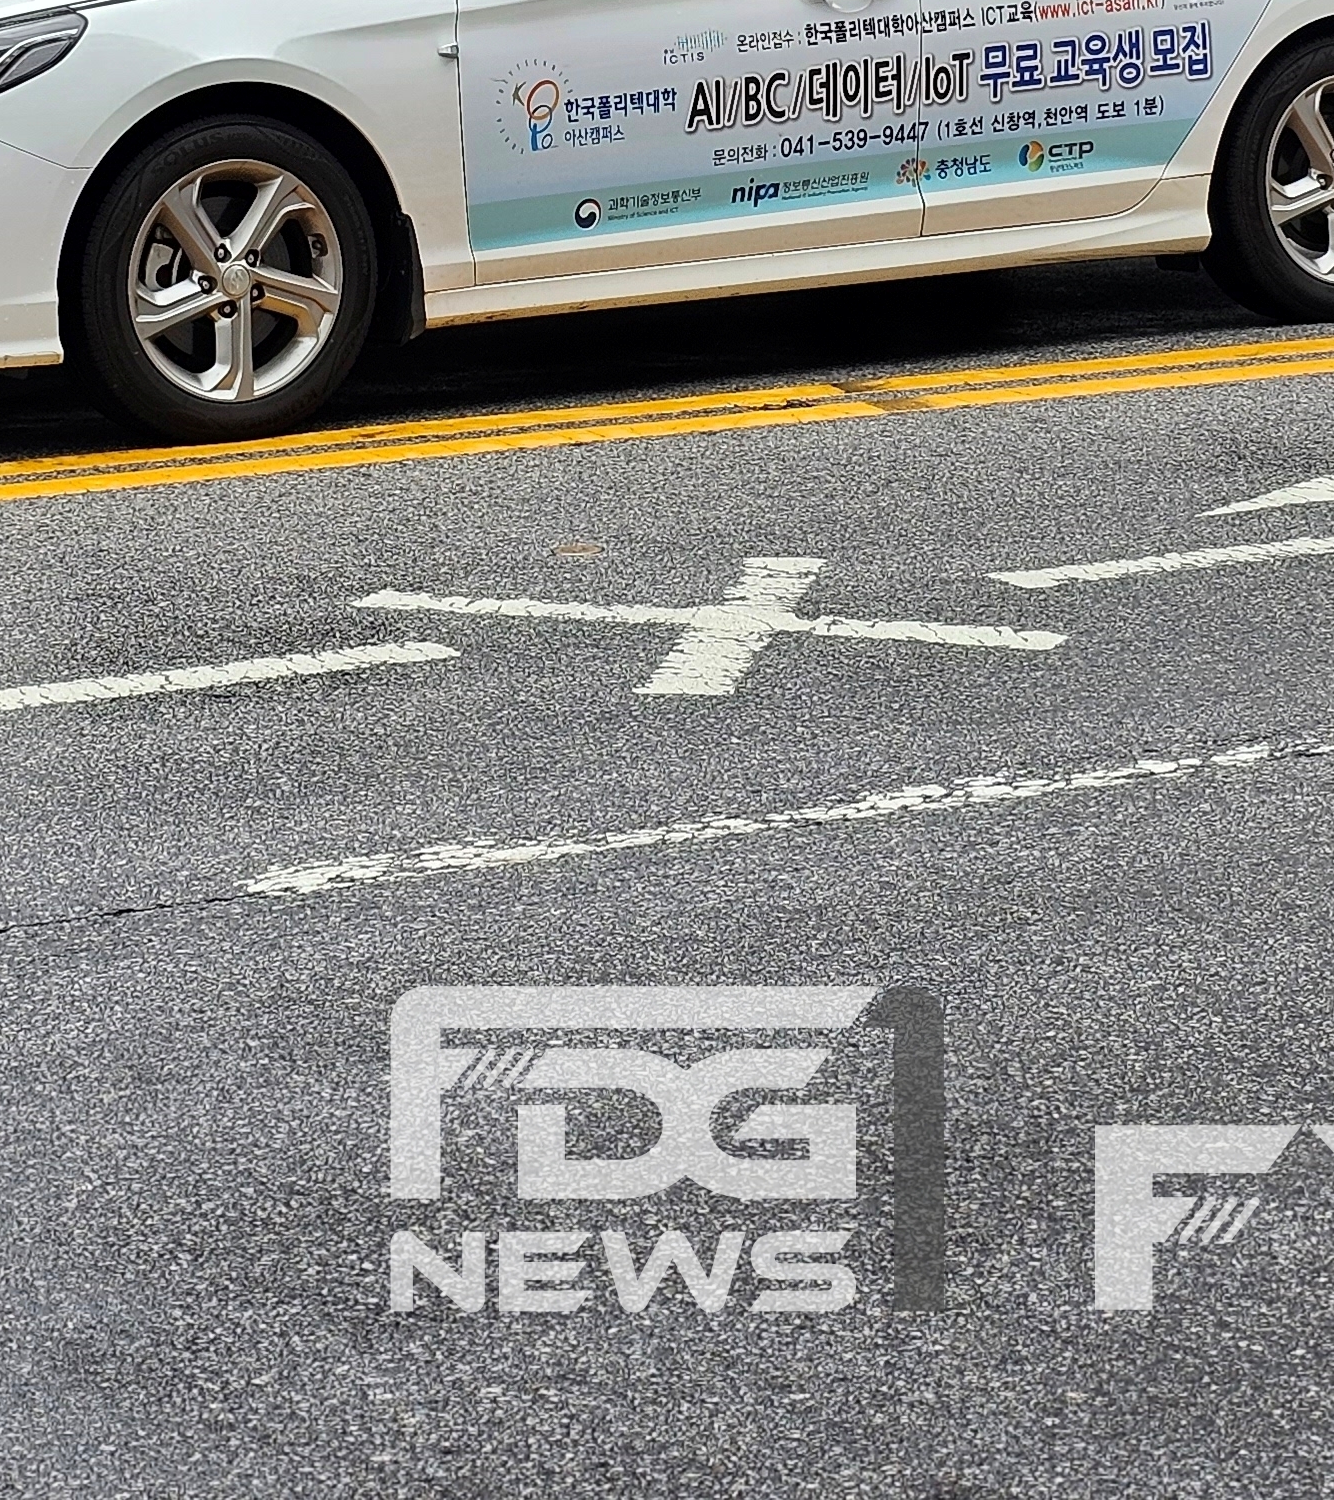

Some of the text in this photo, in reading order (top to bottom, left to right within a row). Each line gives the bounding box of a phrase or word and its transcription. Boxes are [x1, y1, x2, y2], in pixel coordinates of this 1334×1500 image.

[804, 6, 976, 47] 한국폴리텍대학아산캠퍼스
[686, 20, 1212, 131] AI/BC/데이터/IoT 무료 교육생 모집
[563, 87, 678, 123] 한국폴리텍대학
[564, 124, 626, 148] 아산캠퍼스
[712, 145, 769, 167] 문의전화
[780, 121, 930, 158] 041-539-9447
[936, 114, 985, 142] (1호선
[990, 103, 1089, 132] 신창역,천안역
[1095, 99, 1127, 121] 도보
[1133, 94, 1165, 118] 1분)
[1048, 140, 1094, 160] CTP
[935, 154, 992, 180] 충청남도
[731, 177, 781, 208] nipa
[782, 171, 870, 194] 정보통신산업진흥원
[608, 187, 703, 212] 과학기술정보통신부
